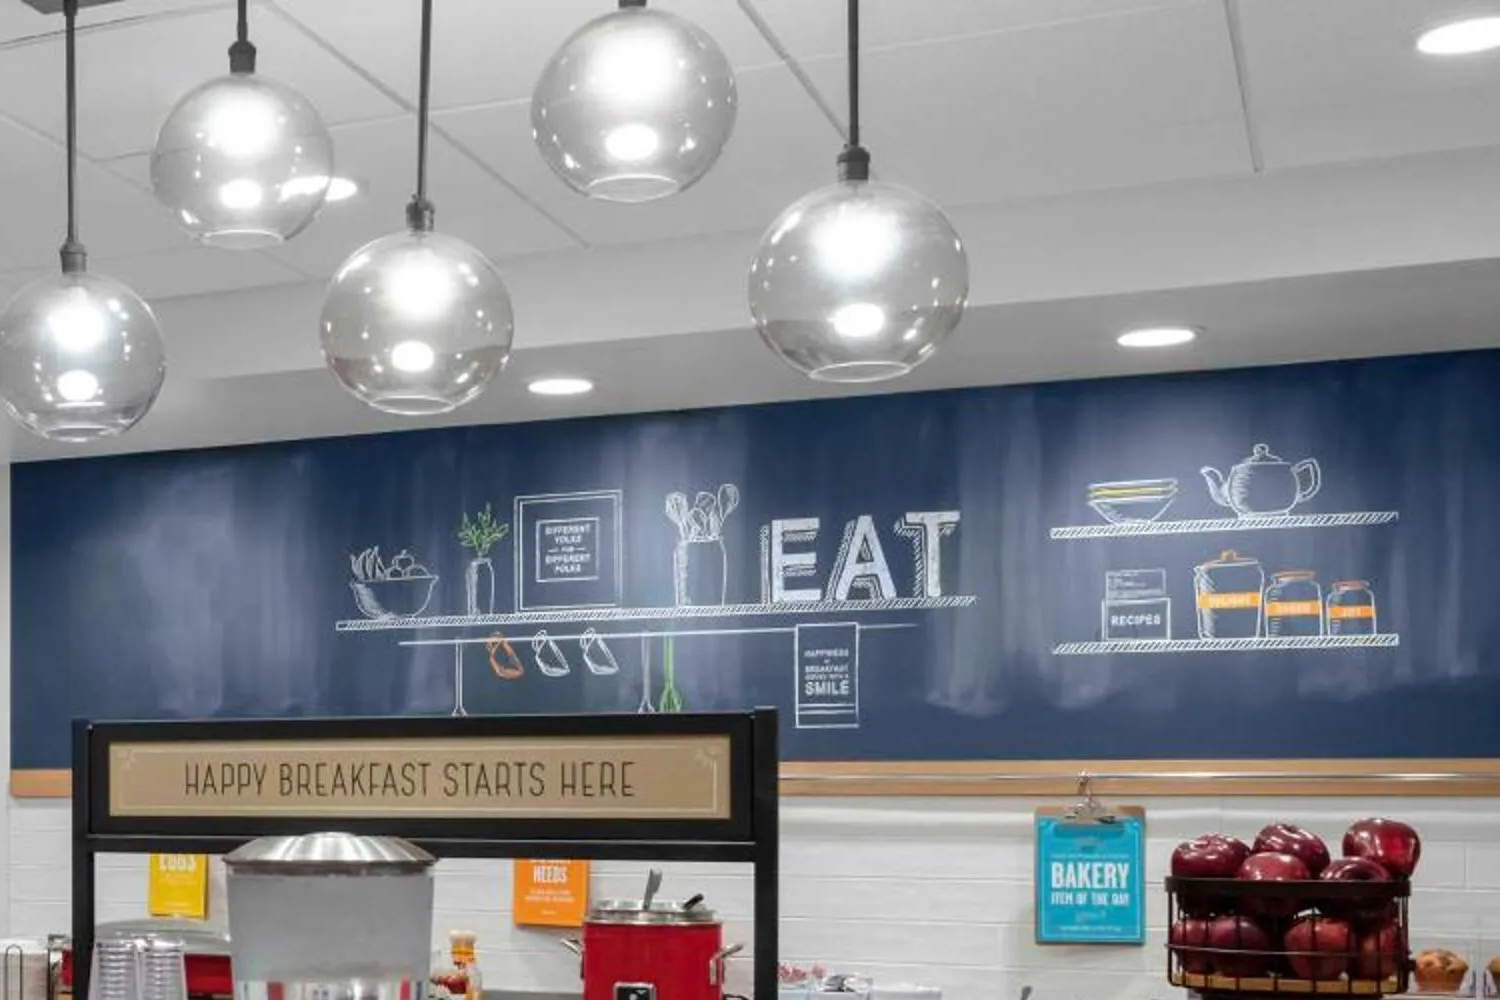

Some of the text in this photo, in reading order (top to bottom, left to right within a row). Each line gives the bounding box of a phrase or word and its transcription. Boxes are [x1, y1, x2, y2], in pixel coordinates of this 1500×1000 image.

[545, 523, 591, 536] DIFFERENT
[545, 553, 590, 565] DIFFERENT
[760, 510, 961, 602] EAT
[1111, 614, 1161, 626] RECIPES
[804, 679, 849, 696] SMILE
[184, 761, 635, 797] HAPPY BREAKFAST STARTS HERE
[1050, 862, 1130, 889] BAKERY
[1050, 891, 1131, 907] ITEM OF THE DAY
